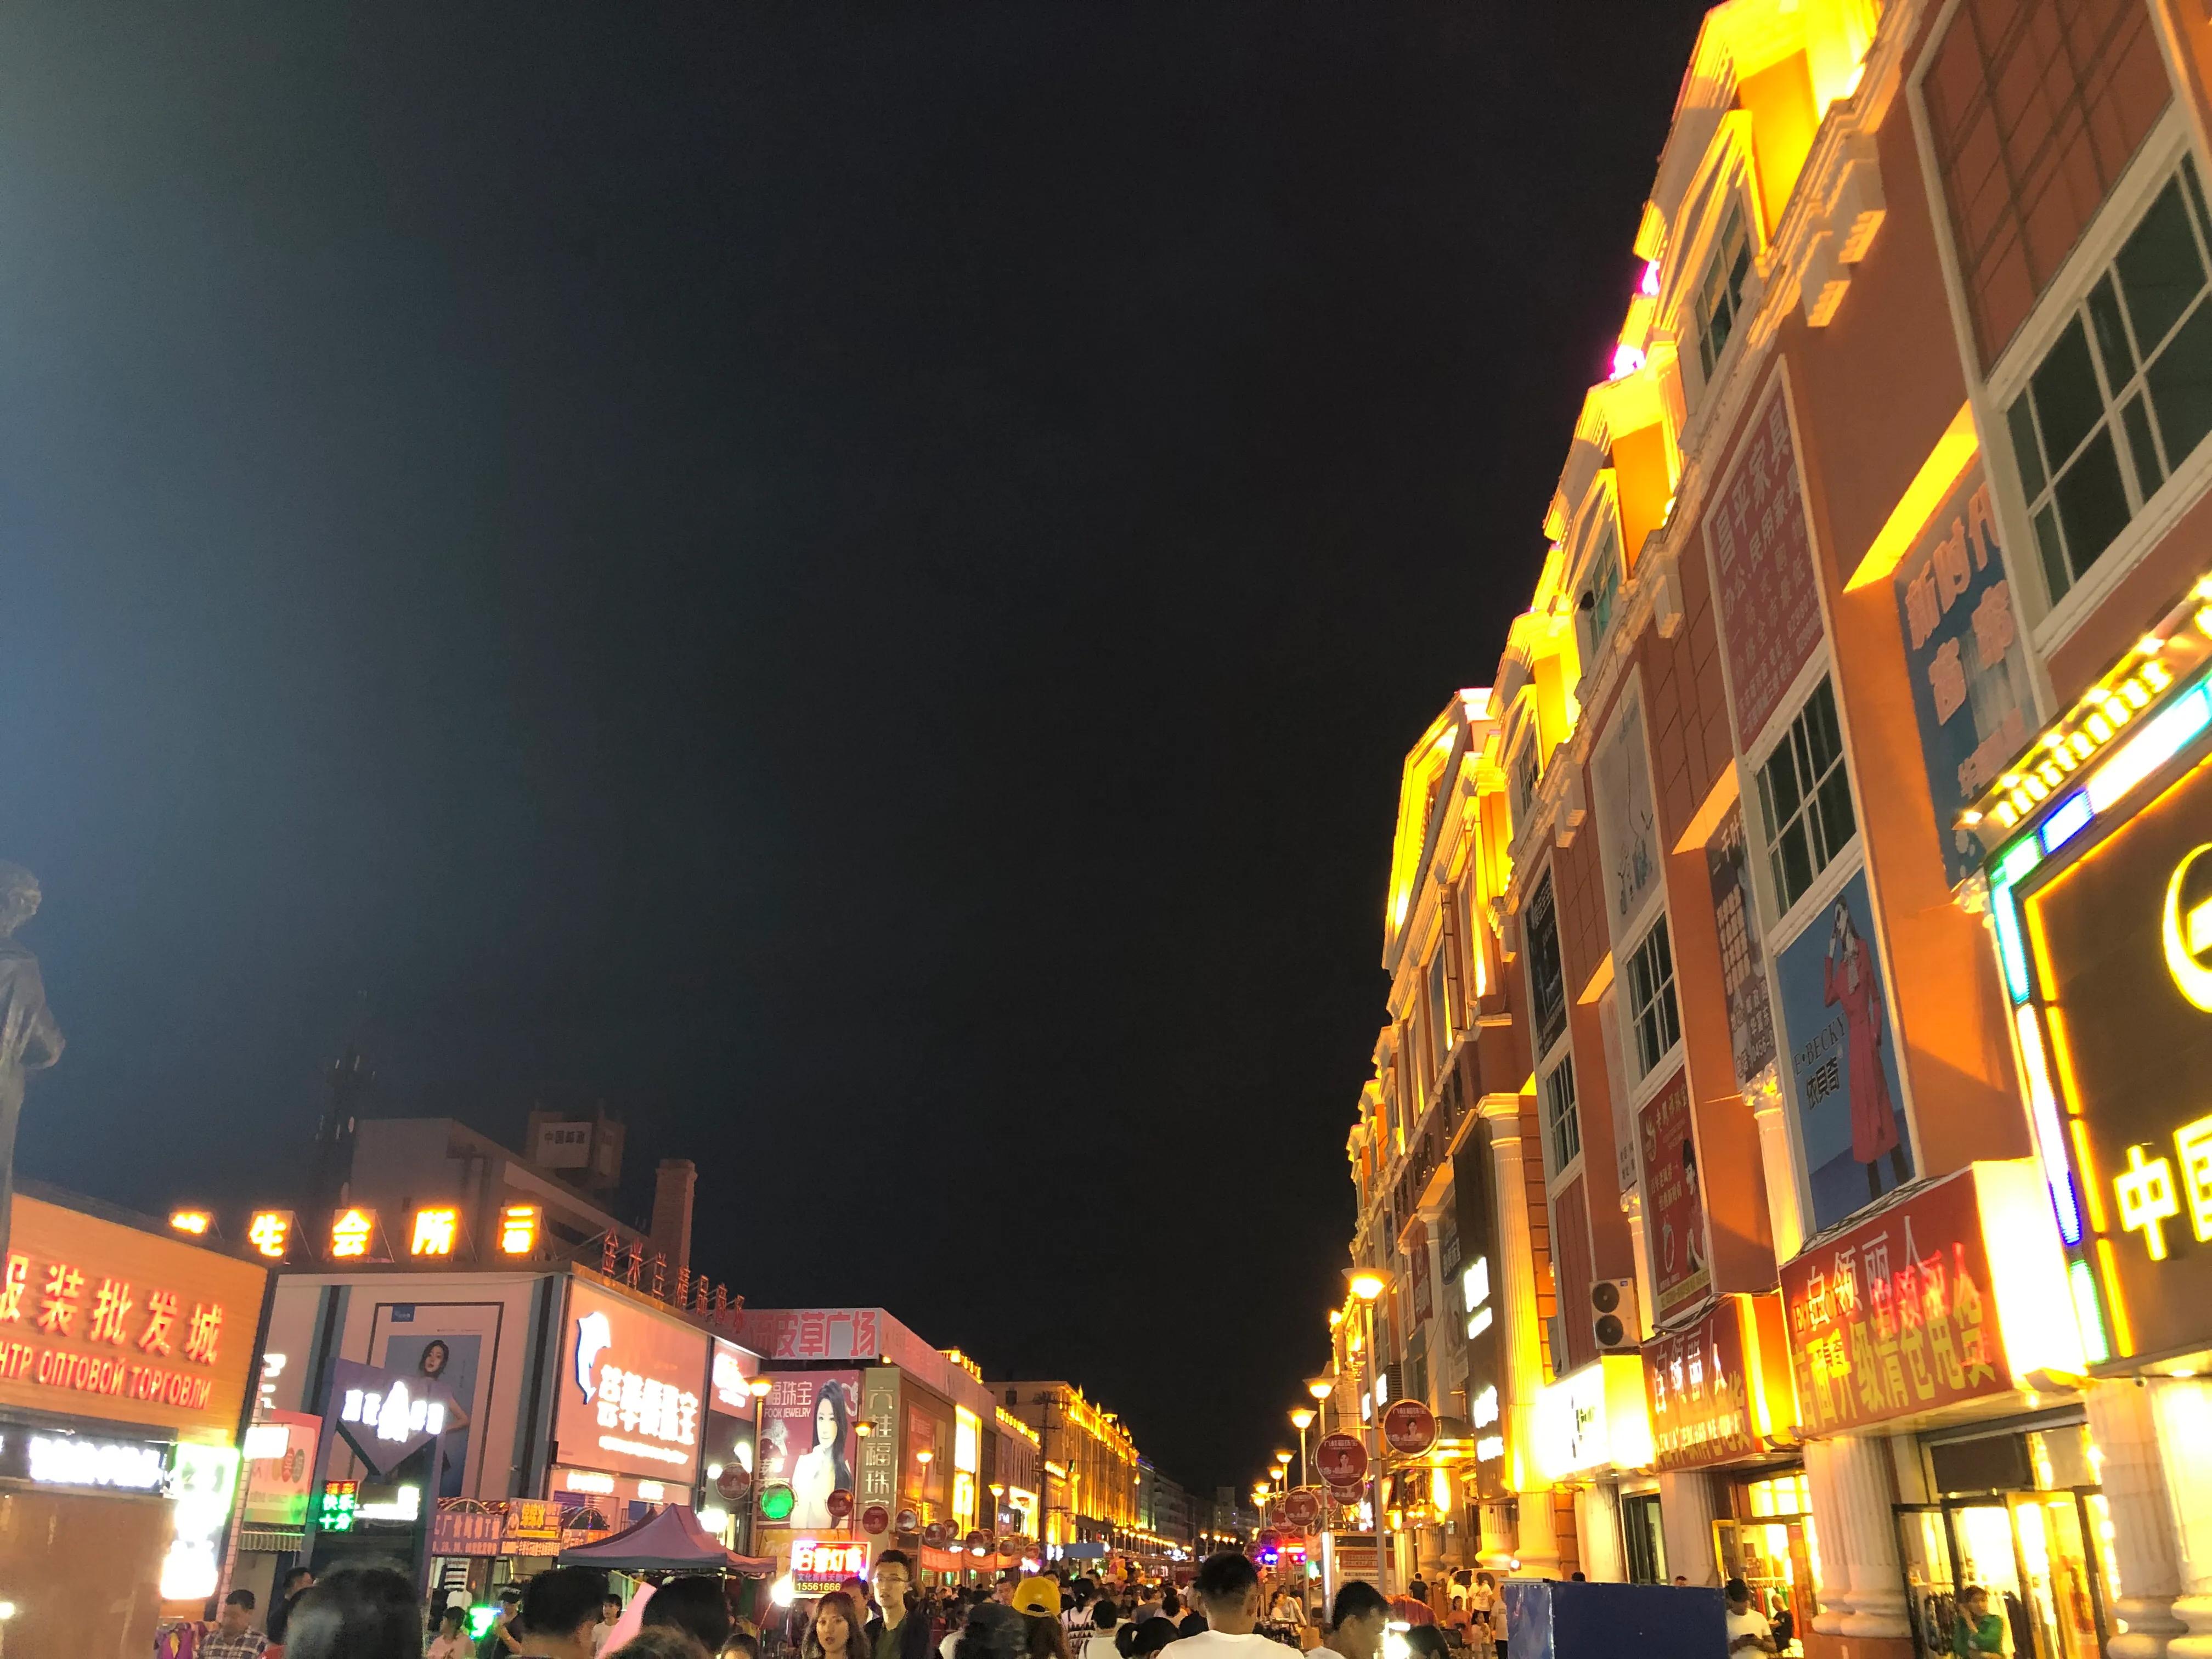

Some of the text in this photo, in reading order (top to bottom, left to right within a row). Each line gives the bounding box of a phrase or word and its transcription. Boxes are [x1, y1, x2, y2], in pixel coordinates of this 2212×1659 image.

[1716, 397, 1791, 575] 昌平家具
[38, 1350, 125, 1397] ОПТОВОЙ
[131, 1365, 212, 1410] ТОРГОВЛИ
[783, 1407, 811, 1419] JEWELRY
[865, 1386, 893, 1510] 六桂福珠
[319, 1513, 352, 1530] 十分
